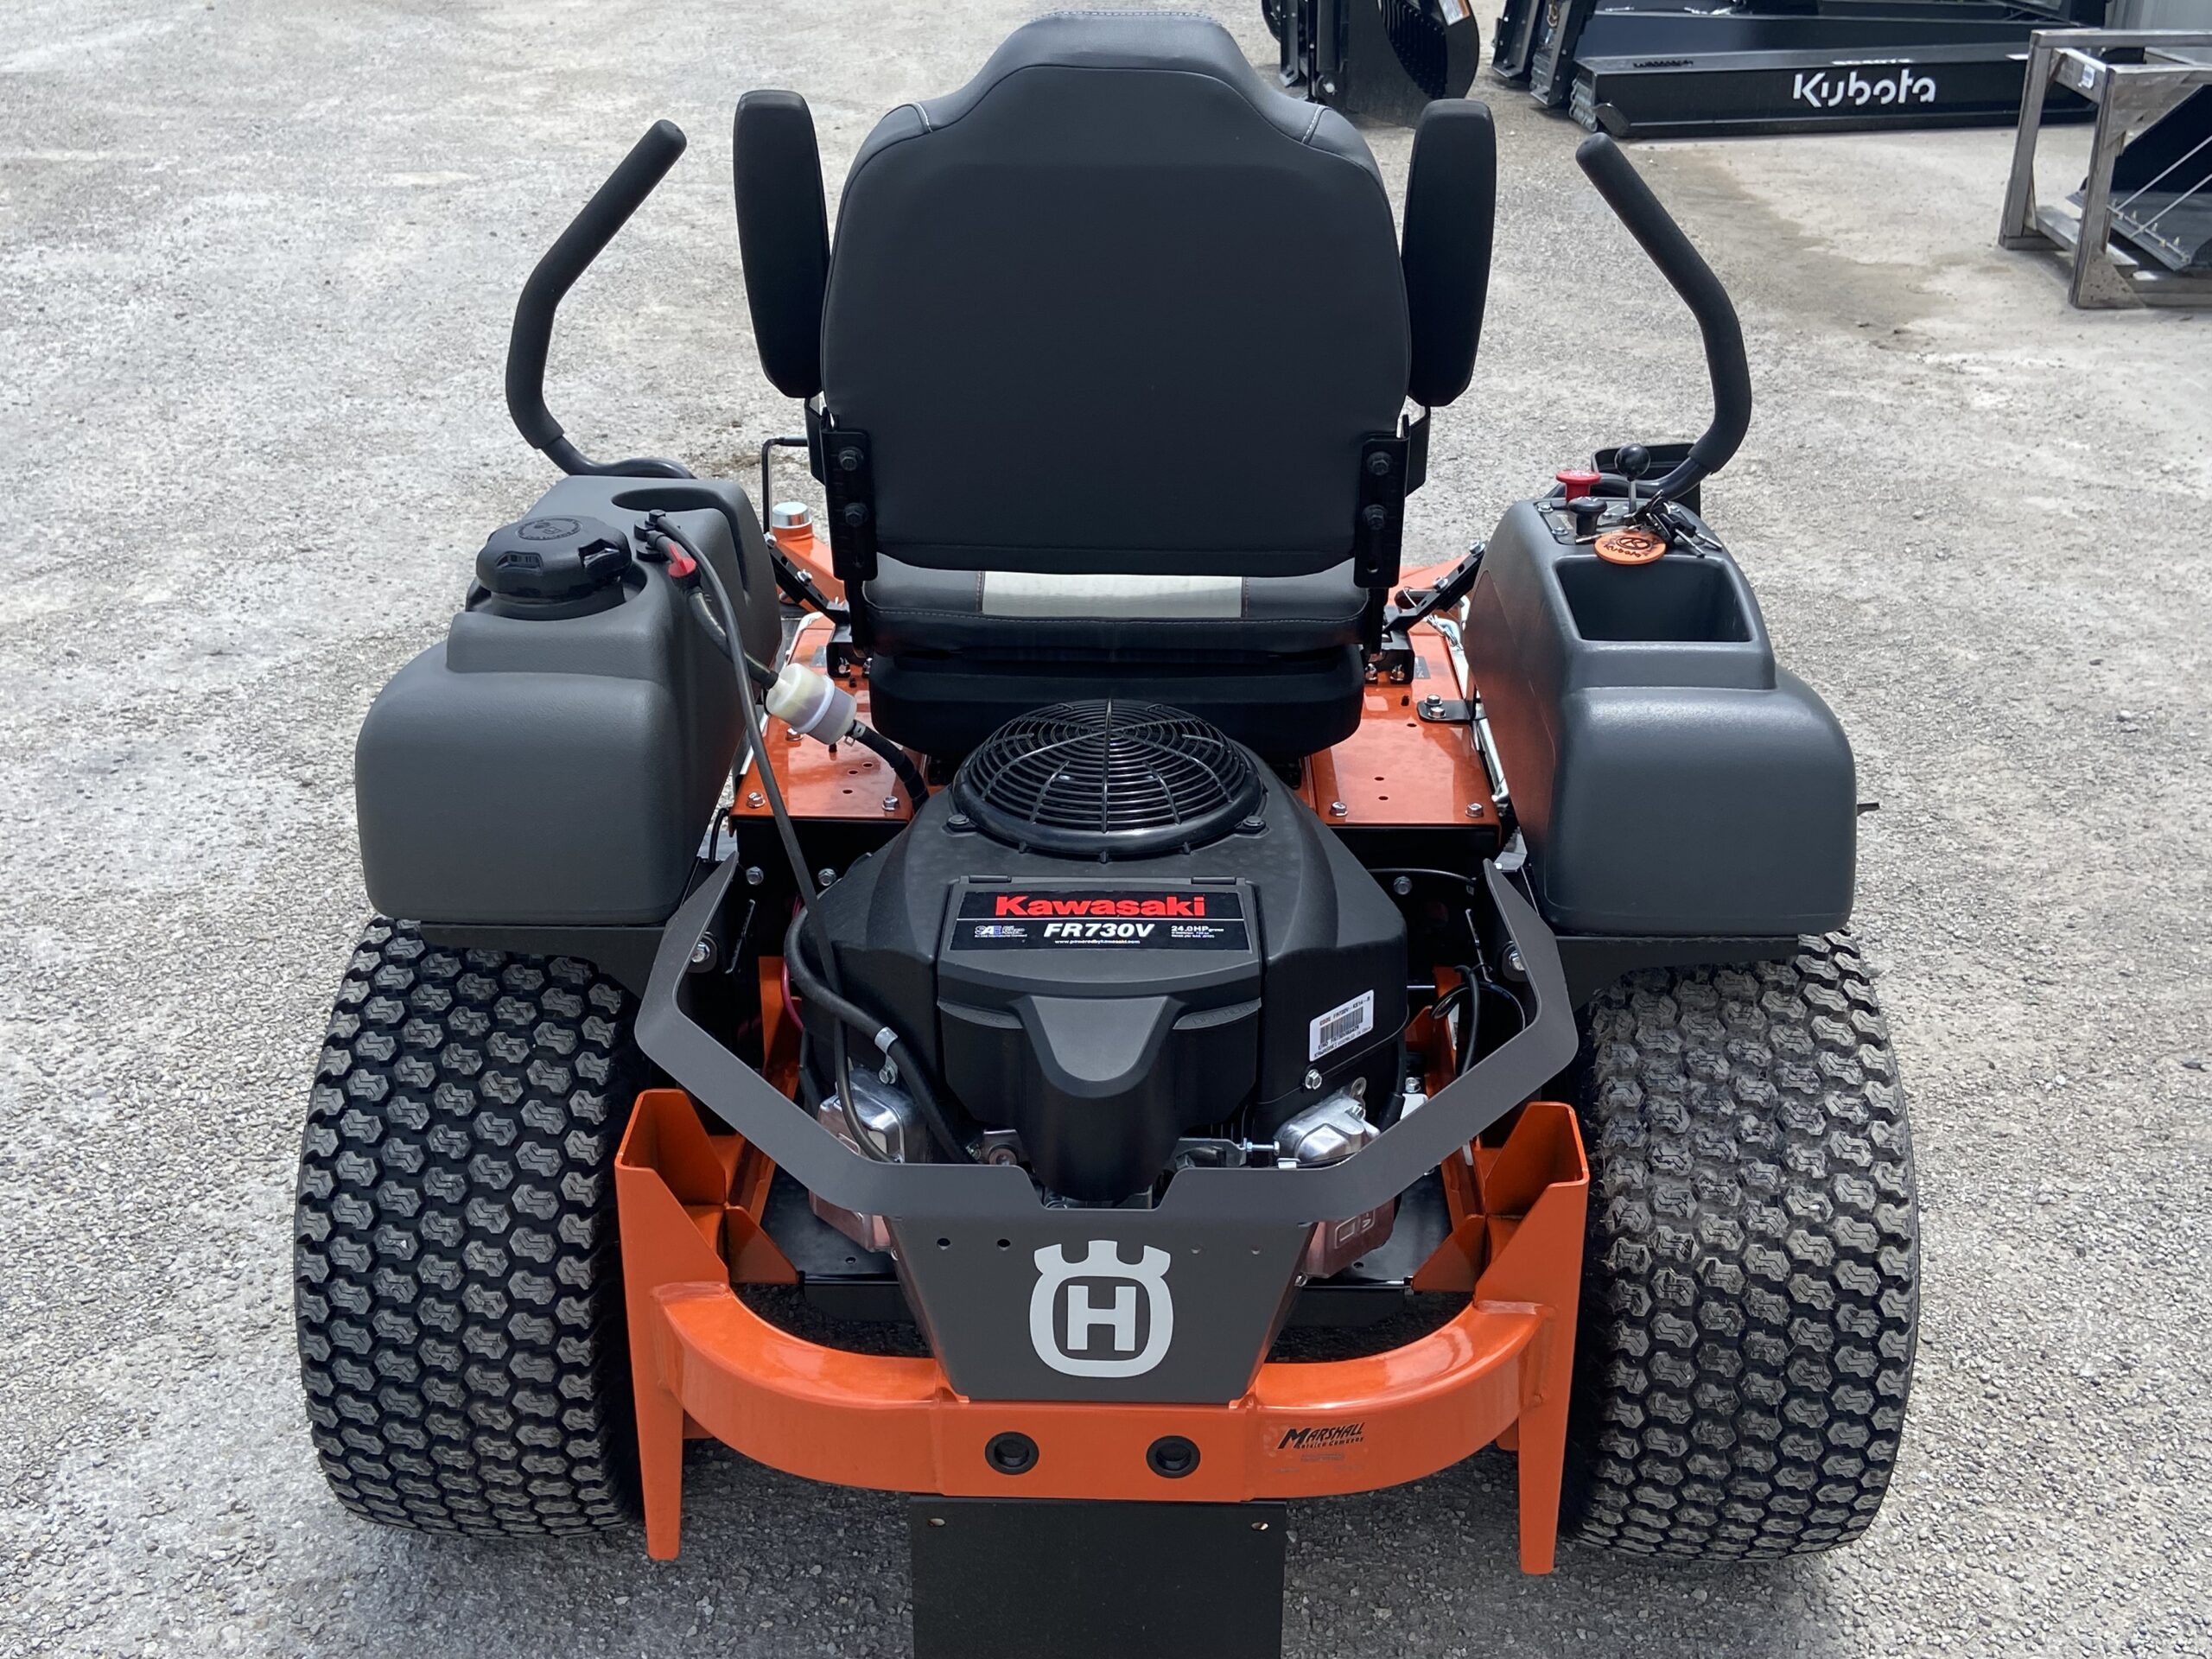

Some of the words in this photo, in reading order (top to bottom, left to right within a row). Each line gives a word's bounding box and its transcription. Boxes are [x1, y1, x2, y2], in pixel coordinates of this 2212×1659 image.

[1792, 68, 1936, 108] Kubota
[995, 895, 1205, 917] Kawasaki
[1043, 922, 1156, 938] FR730V
[1278, 1422, 1365, 1449] MARSHALL
